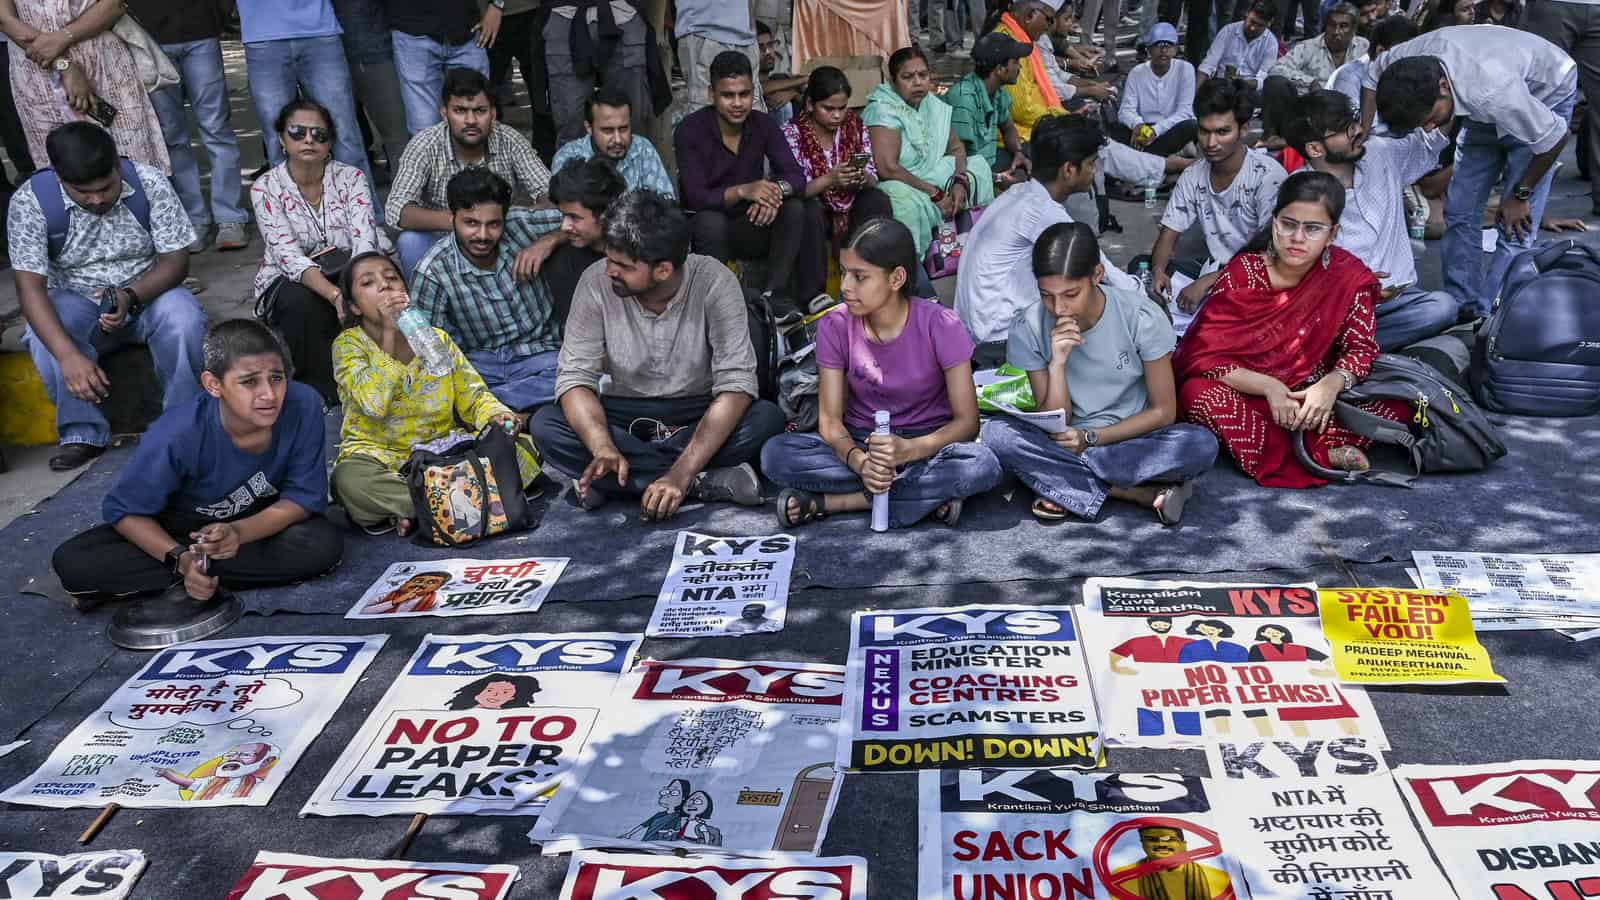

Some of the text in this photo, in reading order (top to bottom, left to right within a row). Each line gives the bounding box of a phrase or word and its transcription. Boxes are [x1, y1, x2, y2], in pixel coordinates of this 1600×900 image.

[682, 535, 790, 555] KYS
[463, 561, 540, 583] चुप्पी
[682, 573, 713, 585] नहीं
[440, 579, 543, 609] प्रधान?
[475, 578, 507, 590] क्यों
[681, 586, 737, 602] NTA
[1106, 590, 1202, 599] Krantikari
[1108, 604, 1216, 613] Sangathan
[1227, 589, 1318, 616] KYS
[1338, 592, 1449, 607] SYSTEM
[874, 610, 1062, 641] KYS
[1346, 605, 1445, 625] FAILED
[1364, 623, 1433, 640] YOU!
[159, 642, 347, 674] KYS
[426, 640, 618, 669] KYS
[911, 644, 1071, 661] EDUCATION
[1344, 645, 1403, 657] PRADEEP
[911, 655, 1043, 672] MINISTER
[651, 667, 844, 697] KYS
[909, 674, 1078, 692] COACHING
[1184, 664, 1273, 687] NO TO
[145, 680, 266, 699] मोदी है तो
[871, 653, 891, 727] NEXUS
[909, 687, 1060, 706] CENTRES
[1142, 684, 1334, 708] PAPER LEAKS!
[229, 695, 251, 713] है
[384, 715, 578, 745] NO TO
[909, 710, 1086, 728] SCAMSTERS
[67, 754, 118, 765] PAPER
[374, 744, 563, 769] PAPER
[864, 736, 1096, 766] DOWN! DOWN!
[1219, 737, 1379, 779] KYS
[60, 765, 104, 776] LEAK
[347, 767, 553, 799] LEAKS
[959, 769, 1189, 801] KYS
[1428, 772, 1600, 816] KY
[741, 792, 779, 804] SYSTEM
[987, 801, 1160, 812] Krantikari Yuva Sangathan
[1272, 785, 1347, 806] NTA में
[1249, 807, 1384, 832] भ्रष्टाचार की
[1479, 812, 1549, 824] Krantikari
[953, 828, 1078, 862] SACK
[1264, 829, 1393, 861] सुप्रीम कोर्ट
[1476, 841, 1600, 872] DISBAN
[1268, 859, 1413, 884] की निगरानी
[241, 867, 487, 900] KYS
[599, 868, 843, 900] KYS
[953, 868, 1095, 900] UNION
